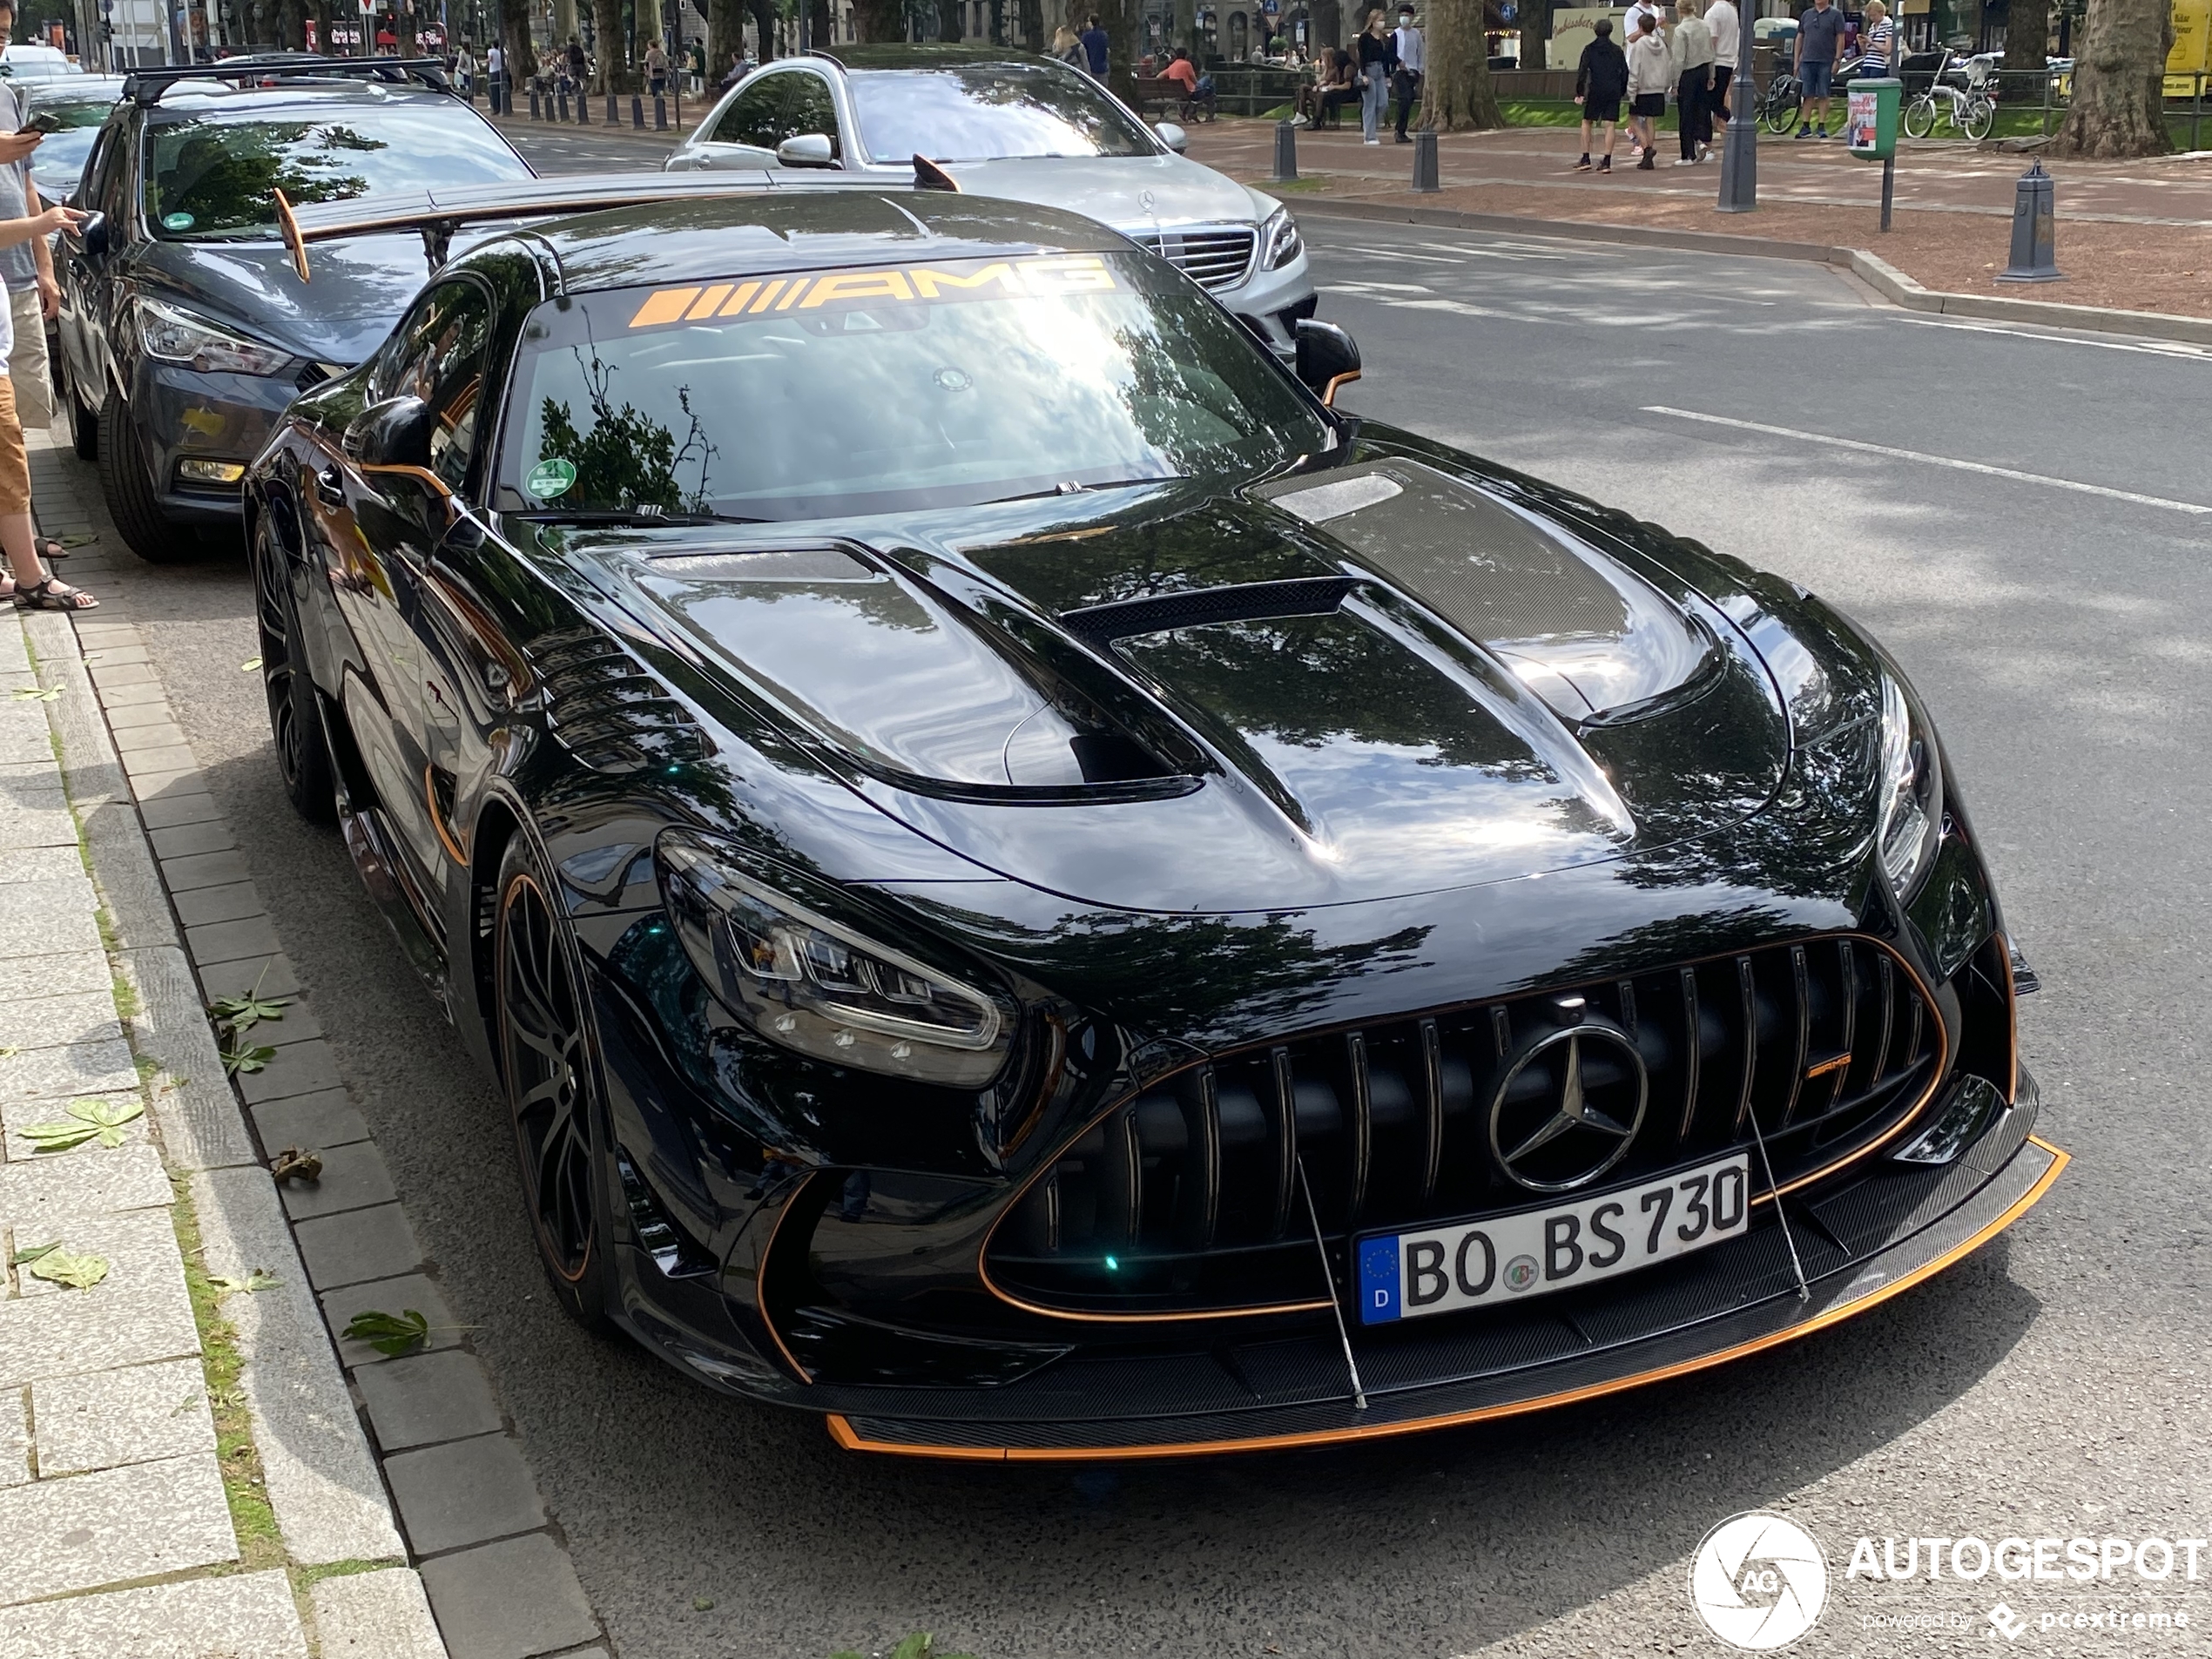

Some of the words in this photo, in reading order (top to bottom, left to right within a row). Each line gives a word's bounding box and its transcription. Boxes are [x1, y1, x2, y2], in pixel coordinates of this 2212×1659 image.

[799, 259, 1116, 308] AMG
[1406, 1231, 1496, 1306] BO
[1545, 1202, 1625, 1281] BS
[1641, 1165, 1743, 1254] 730
[1374, 1289, 1389, 1307] D
